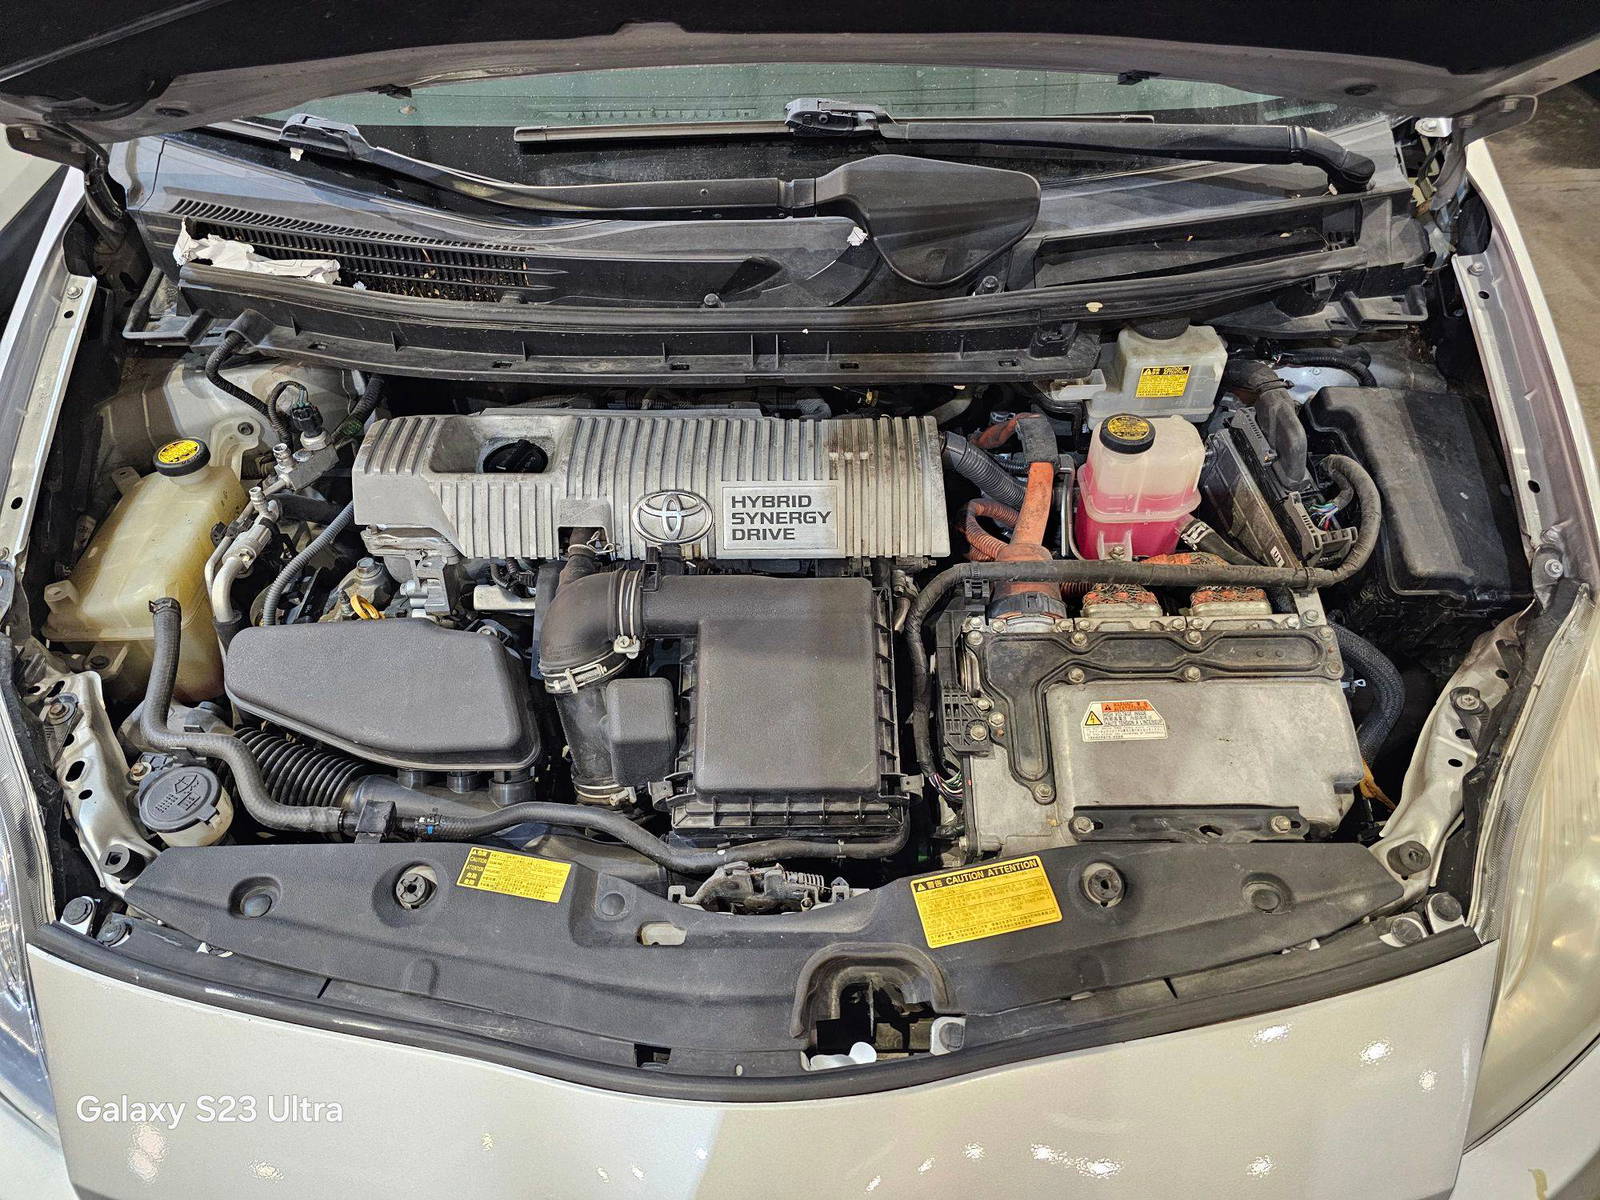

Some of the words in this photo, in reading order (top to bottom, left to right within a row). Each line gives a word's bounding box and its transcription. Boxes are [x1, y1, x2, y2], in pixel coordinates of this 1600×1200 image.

[732, 495, 812, 508] HYBRID
[732, 511, 832, 525] SYNERGY
[732, 528, 795, 541] DRIVE
[945, 870, 985, 885] CAUTION
[987, 859, 1037, 878] ATTENTION
